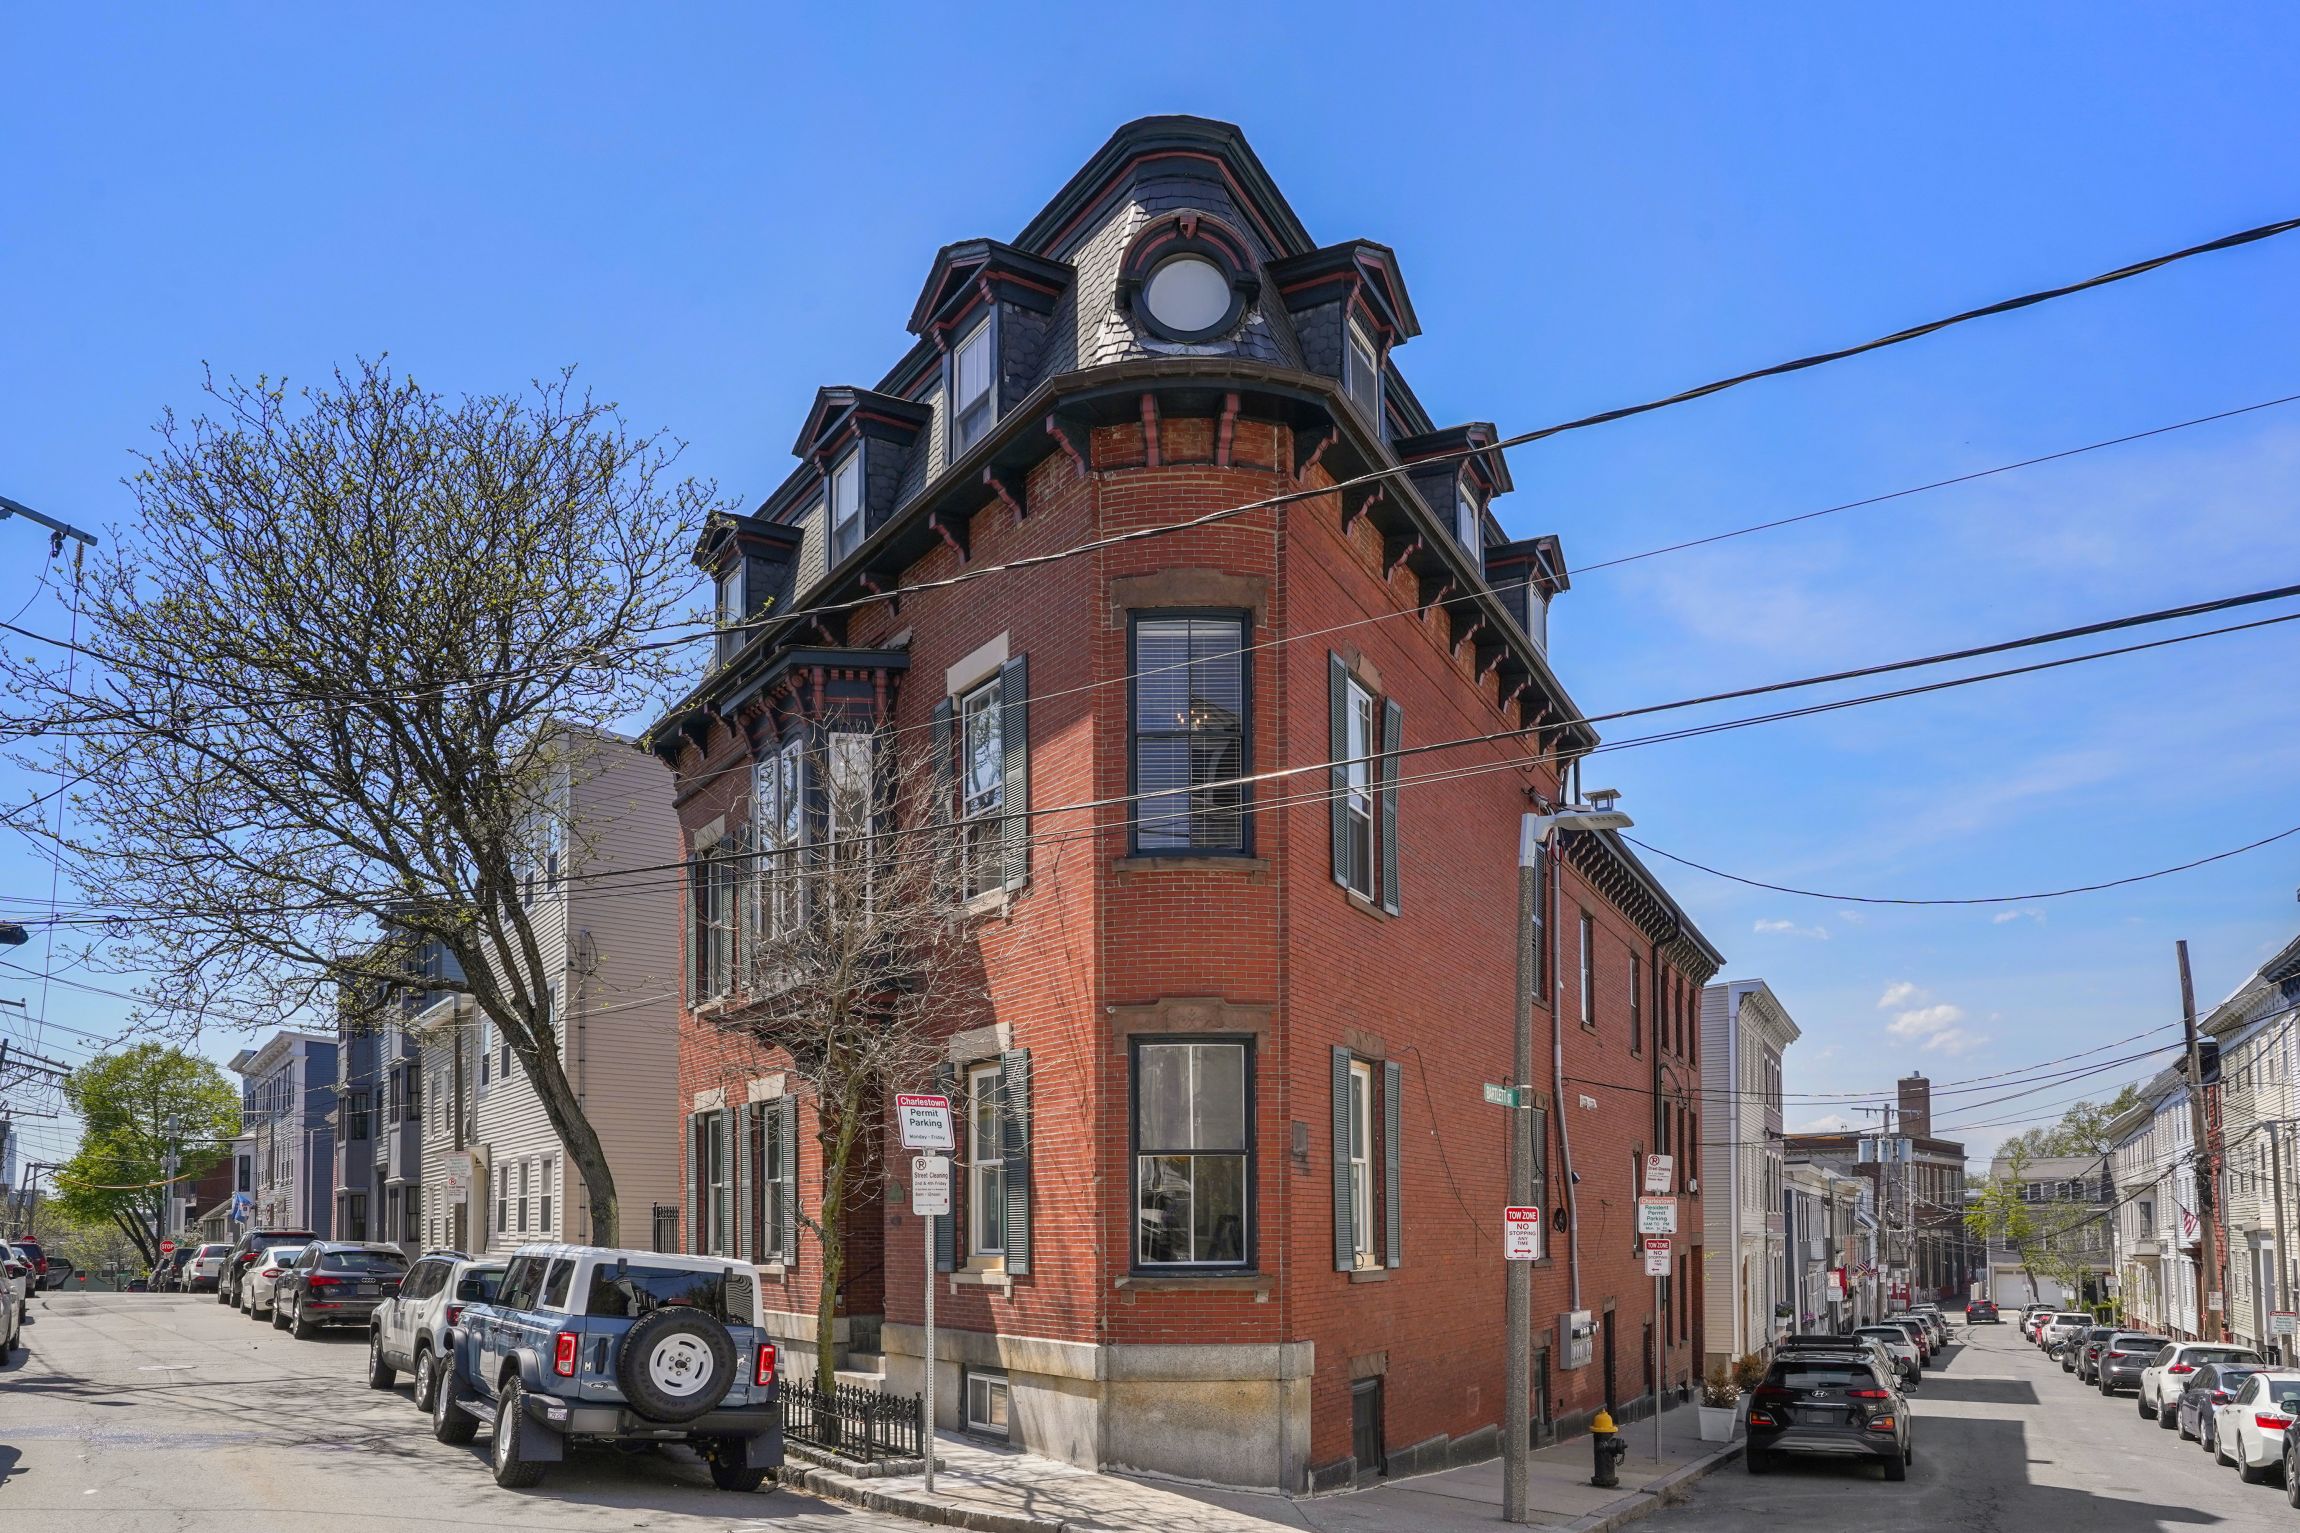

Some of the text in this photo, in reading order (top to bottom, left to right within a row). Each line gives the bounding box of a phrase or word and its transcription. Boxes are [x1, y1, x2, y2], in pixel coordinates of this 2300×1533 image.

[900, 1097, 946, 1107] Charlestown
[910, 1108, 939, 1117] Permit
[909, 1118, 942, 1129] Parking
[929, 1172, 949, 1180] Cleaning
[1508, 1211, 1537, 1220] TOW ZONE
